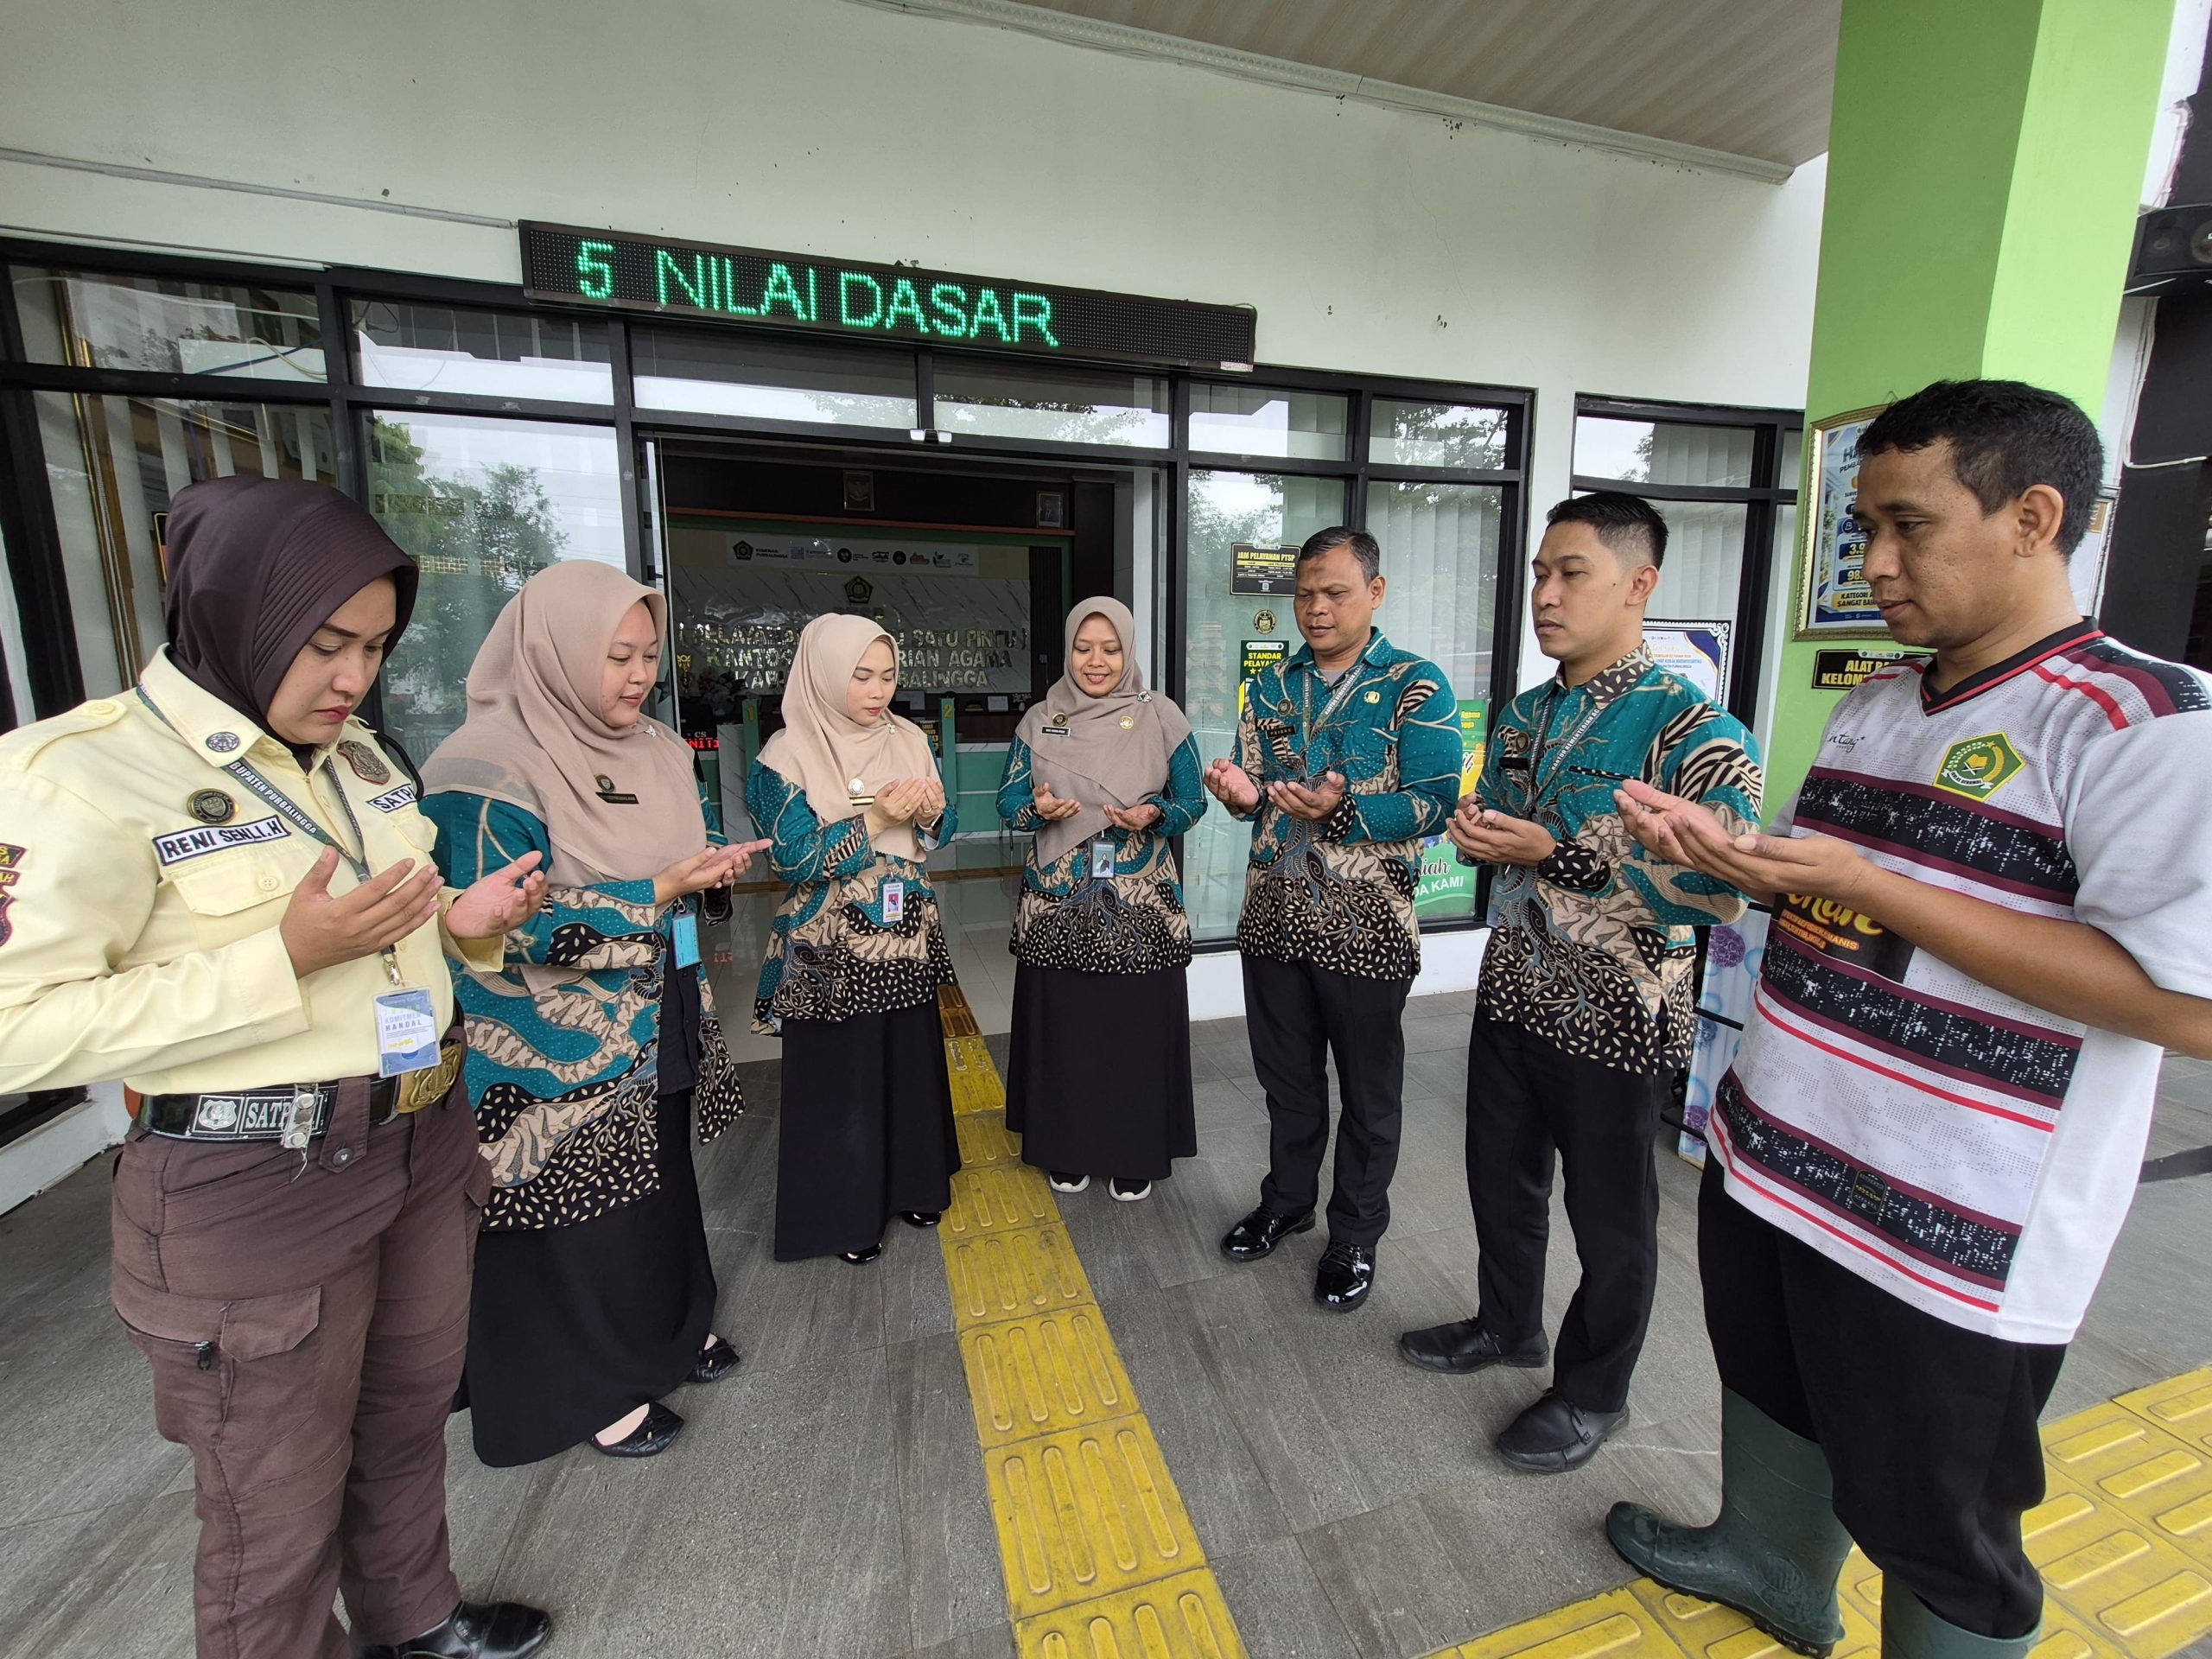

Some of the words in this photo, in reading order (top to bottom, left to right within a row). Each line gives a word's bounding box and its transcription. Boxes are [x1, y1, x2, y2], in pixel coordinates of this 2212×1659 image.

[577, 241, 614, 300] 5
[657, 251, 818, 322] NILAI
[840, 273, 1059, 347] DASAR
[1249, 552, 1281, 561] PELAYANAN
[1837, 599, 1862, 607] SANGAT
[912, 629, 958, 647] SATU
[950, 649, 1013, 668] AGAMA
[1845, 660, 1874, 672] ALAT
[898, 670, 988, 688] BALINGGA
[228, 760, 267, 792] BUPATEN
[264, 789, 318, 834] PURBALINGGA
[372, 788, 415, 810] SATP
[162, 830, 218, 858] RENI
[1431, 876, 1465, 893] KAMI
[385, 1020, 423, 1031] HANDAL
[245, 1102, 292, 1129] SATP
